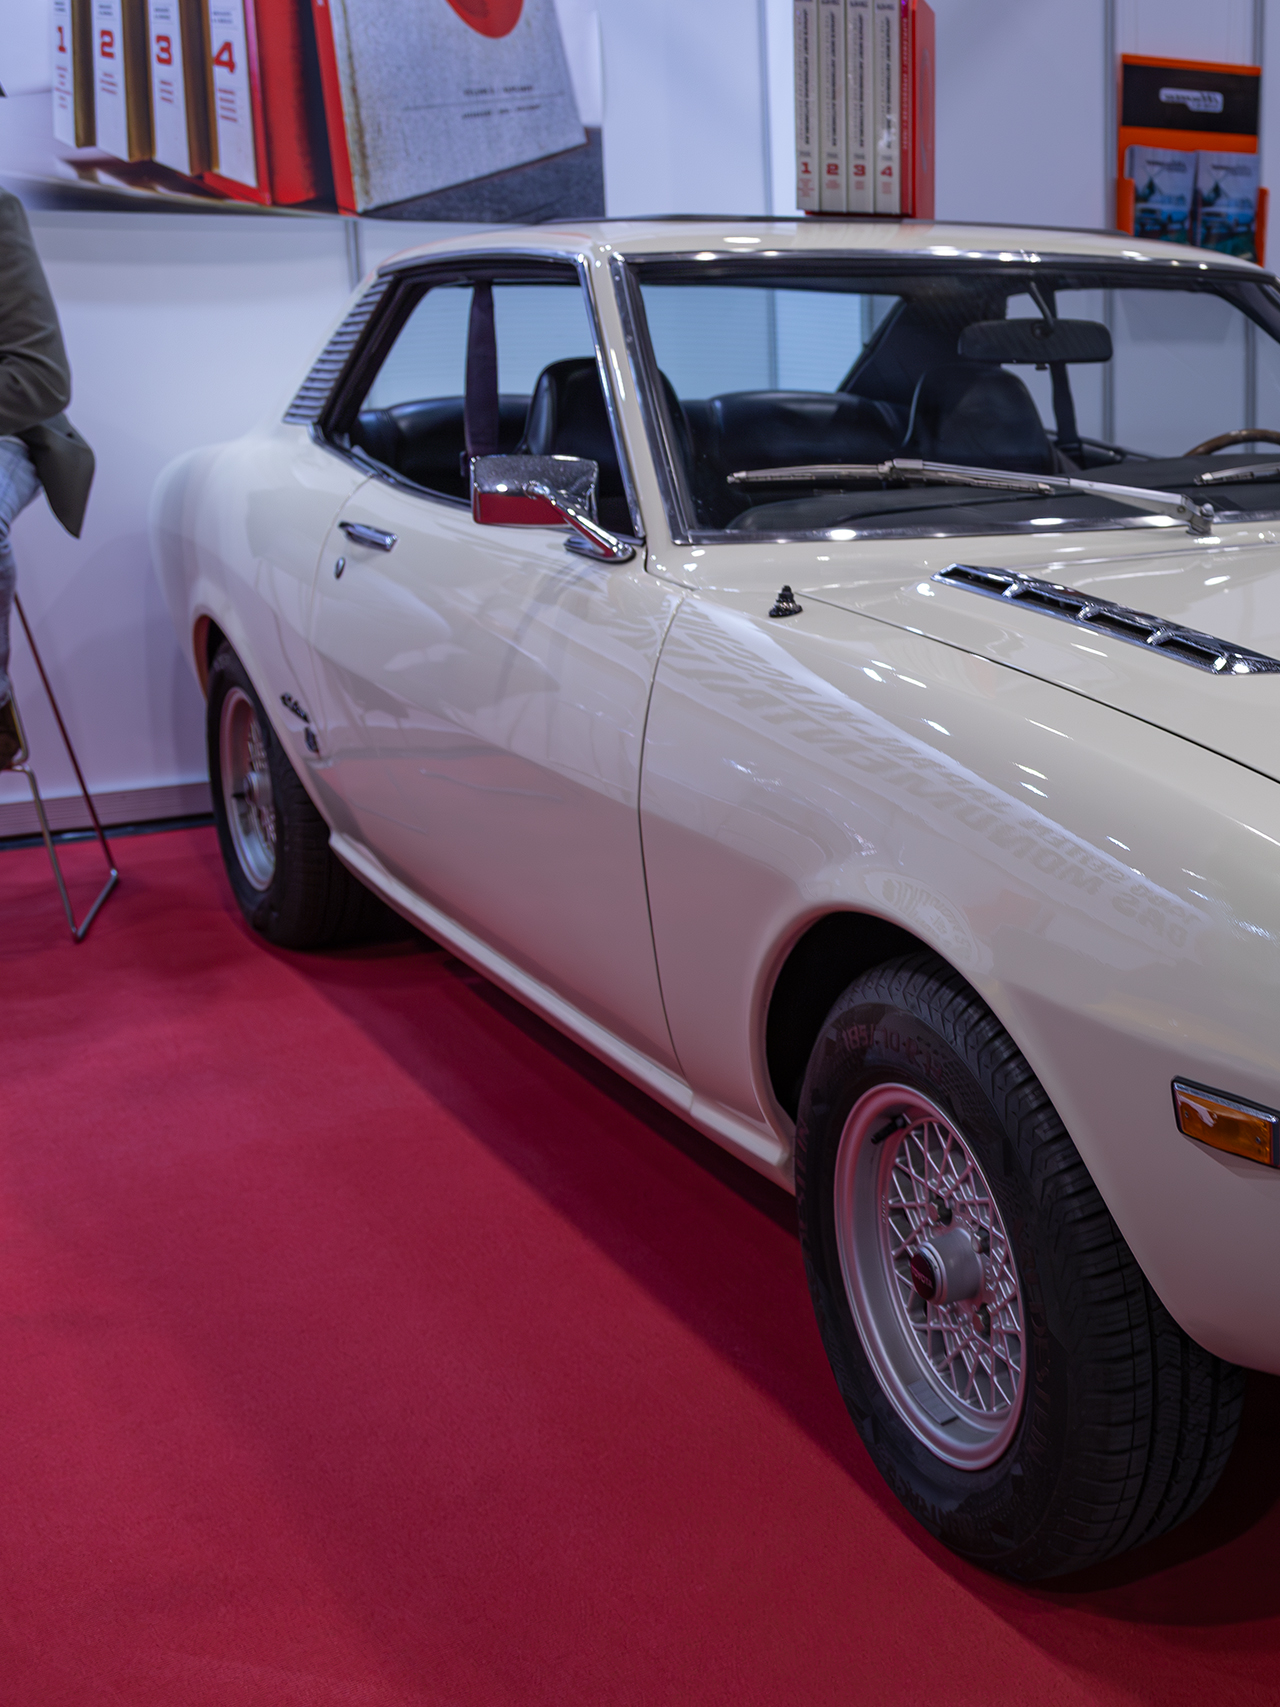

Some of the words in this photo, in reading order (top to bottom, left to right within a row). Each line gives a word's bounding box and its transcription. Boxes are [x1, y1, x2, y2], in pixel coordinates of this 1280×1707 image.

[57, 26, 67, 54] 1
[99, 29, 115, 59] 2
[155, 34, 173, 65] 3
[213, 41, 236, 73] 4
[801, 162, 812, 174] 1
[826, 163, 839, 176] 2
[853, 164, 866, 177] 3
[880, 165, 893, 178] 4
